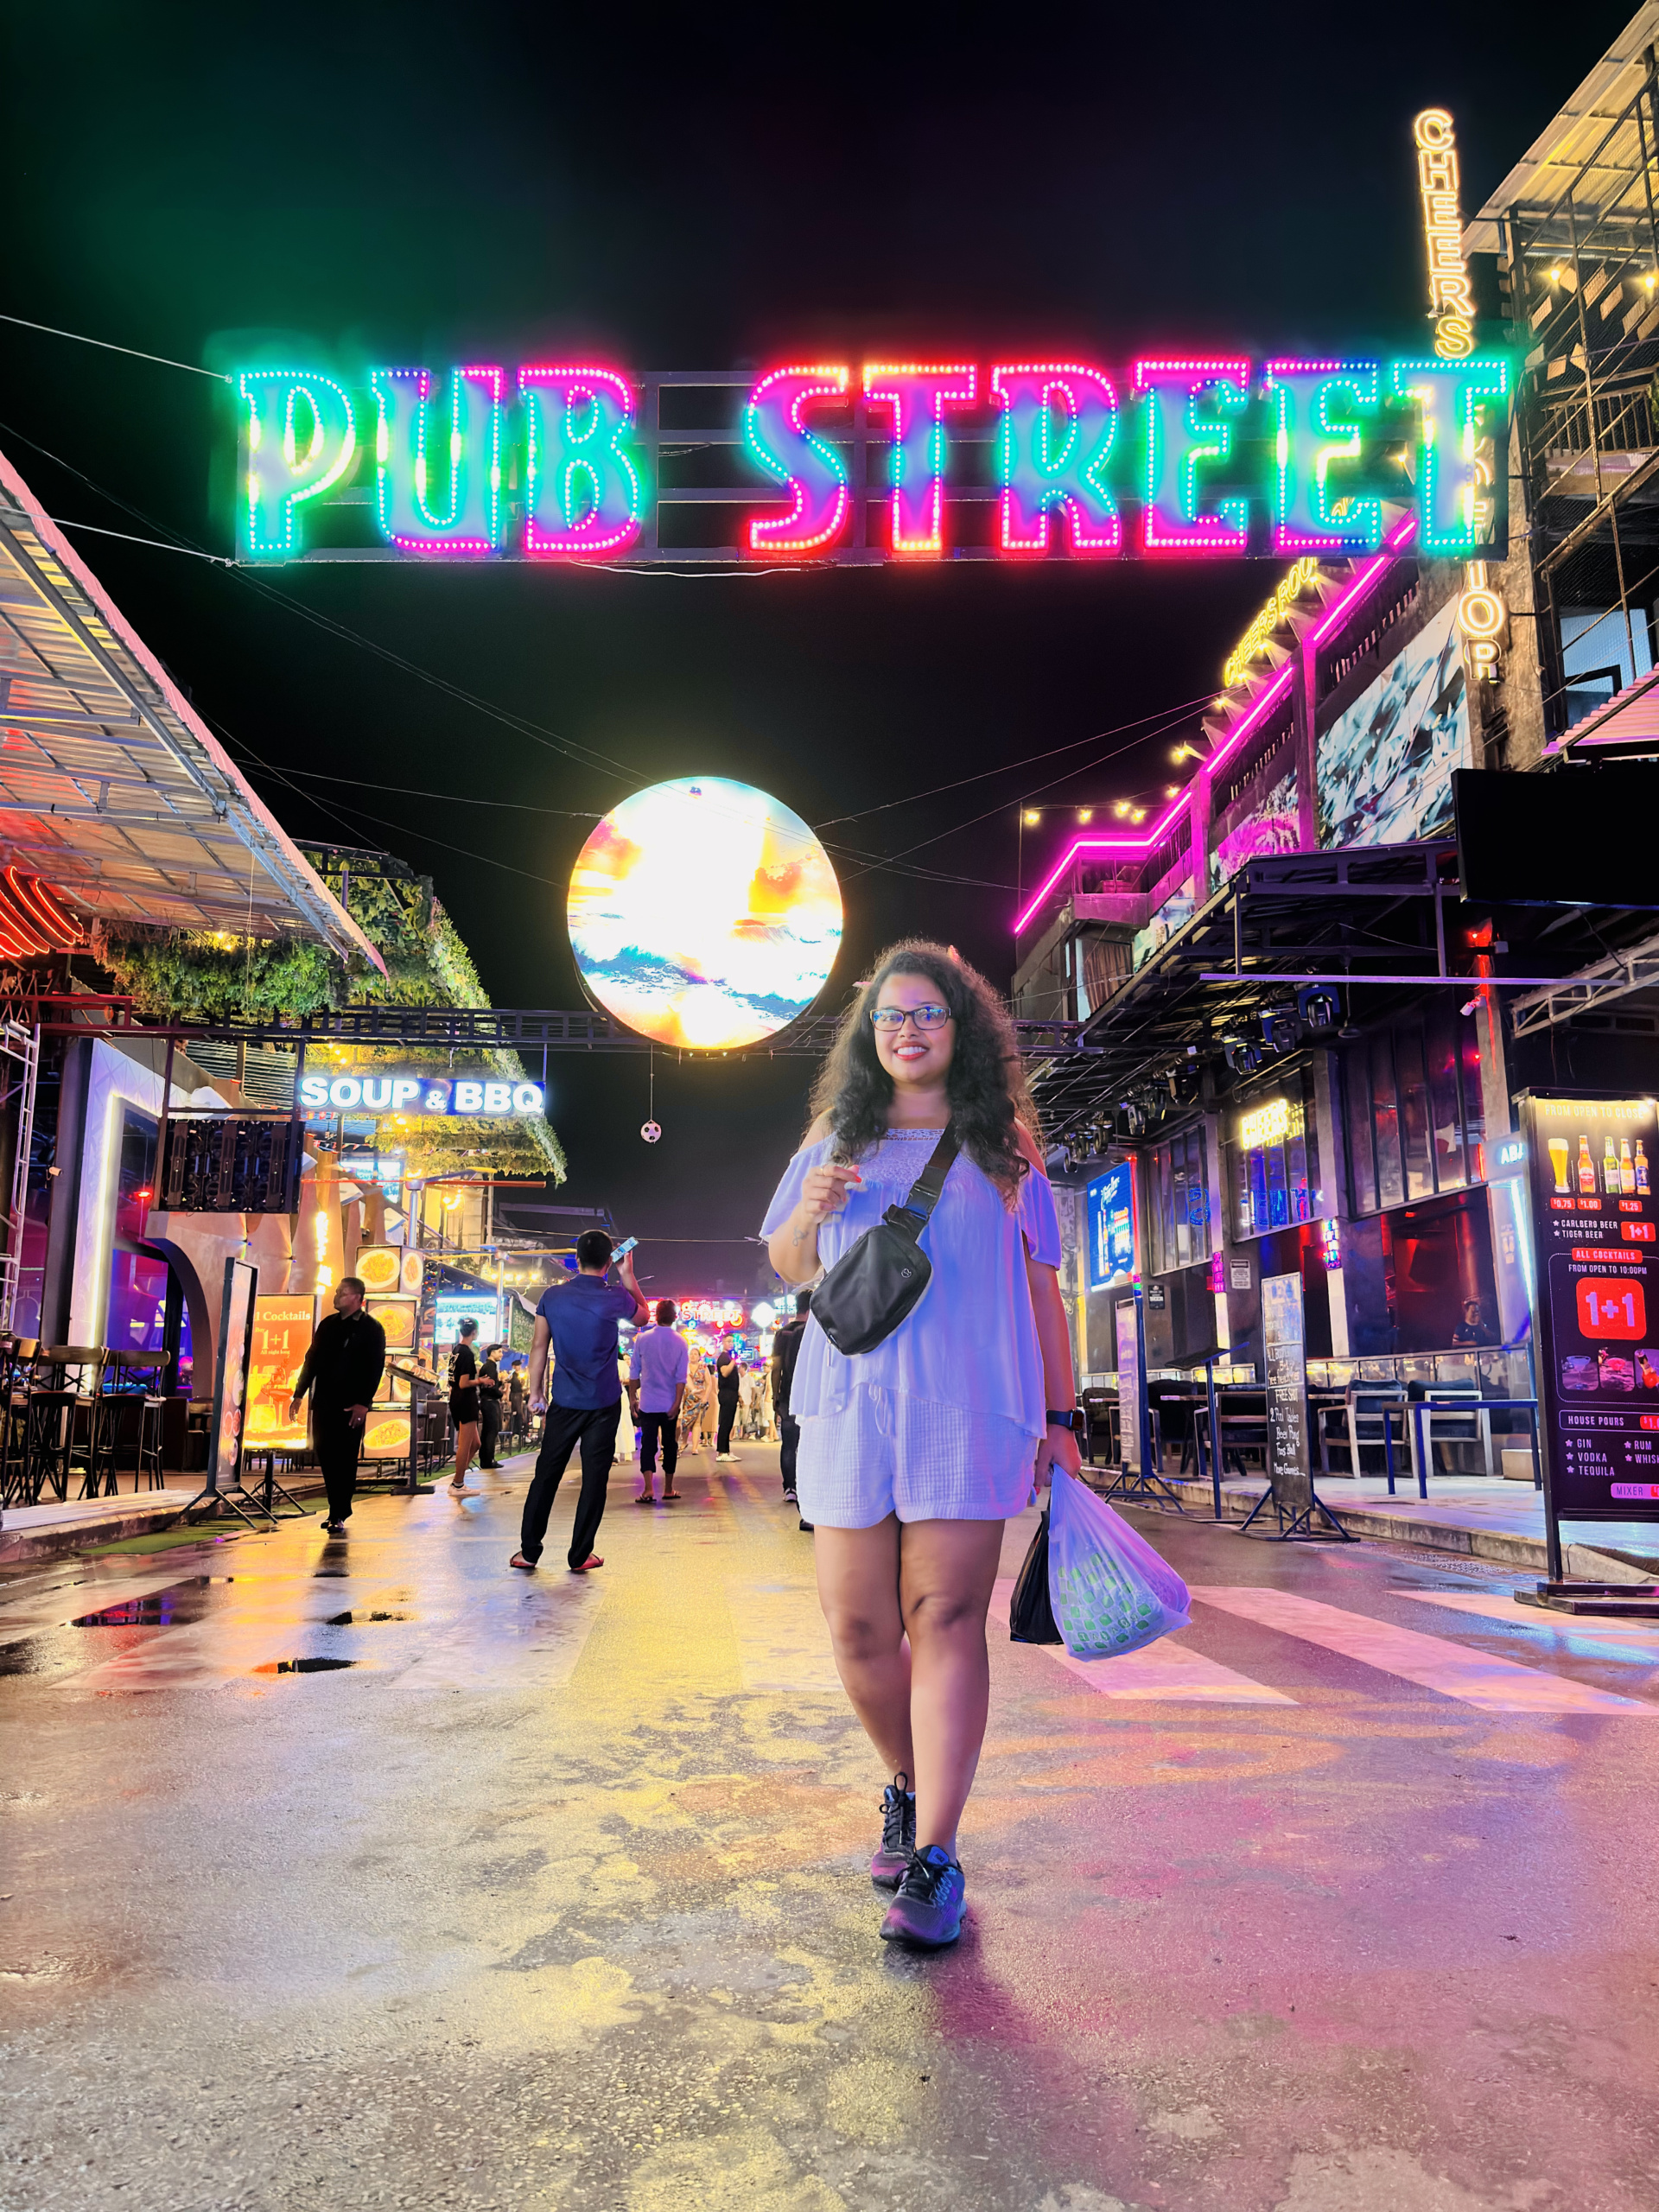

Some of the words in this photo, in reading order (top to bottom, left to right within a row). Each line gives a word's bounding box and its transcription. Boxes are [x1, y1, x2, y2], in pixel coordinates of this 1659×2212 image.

[1414, 108, 1476, 359] CHEERS
[237, 366, 645, 560] PUB
[745, 360, 1512, 560] STREET
[1224, 597, 1278, 689] CHEERS
[300, 1076, 420, 1110] SOUP
[426, 1090, 447, 1111] &
[454, 1081, 544, 1115] BBQ
[1544, 1104, 1571, 1116] FROM
[1573, 1106, 1597, 1117] OPEN
[1601, 1107, 1612, 1118] TO
[1615, 1108, 1643, 1119] CLOSE
[1621, 1201, 1639, 1211] $1.25
[1599, 1221, 1618, 1230] BEER
[1561, 1230, 1583, 1239] TIGER
[1585, 1230, 1604, 1239] BEER
[1629, 1224, 1649, 1240] 1+1
[1576, 1249, 1591, 1259] ALL
[1592, 1250, 1636, 1261] COCKTAILS
[1568, 1263, 1587, 1273] FROM
[1588, 1264, 1607, 1274] OPEN
[1608, 1265, 1618, 1274] TO
[1619, 1266, 1648, 1274] 10:00PM
[263, 1310, 311, 1321] Cocktails
[1586, 1292, 1635, 1327] 1+1
[262, 1329, 289, 1350] 1+1
[1269, 1407, 1275, 1423] 2
[1567, 1415, 1595, 1426] HOUSE
[1599, 1416, 1624, 1427] POURS
[1576, 1439, 1592, 1449] GIN
[1634, 1440, 1652, 1451] RUM
[1577, 1452, 1607, 1462] VODKA
[1579, 1465, 1615, 1477] TEQUILA
[1616, 1486, 1643, 1497] MIXER
